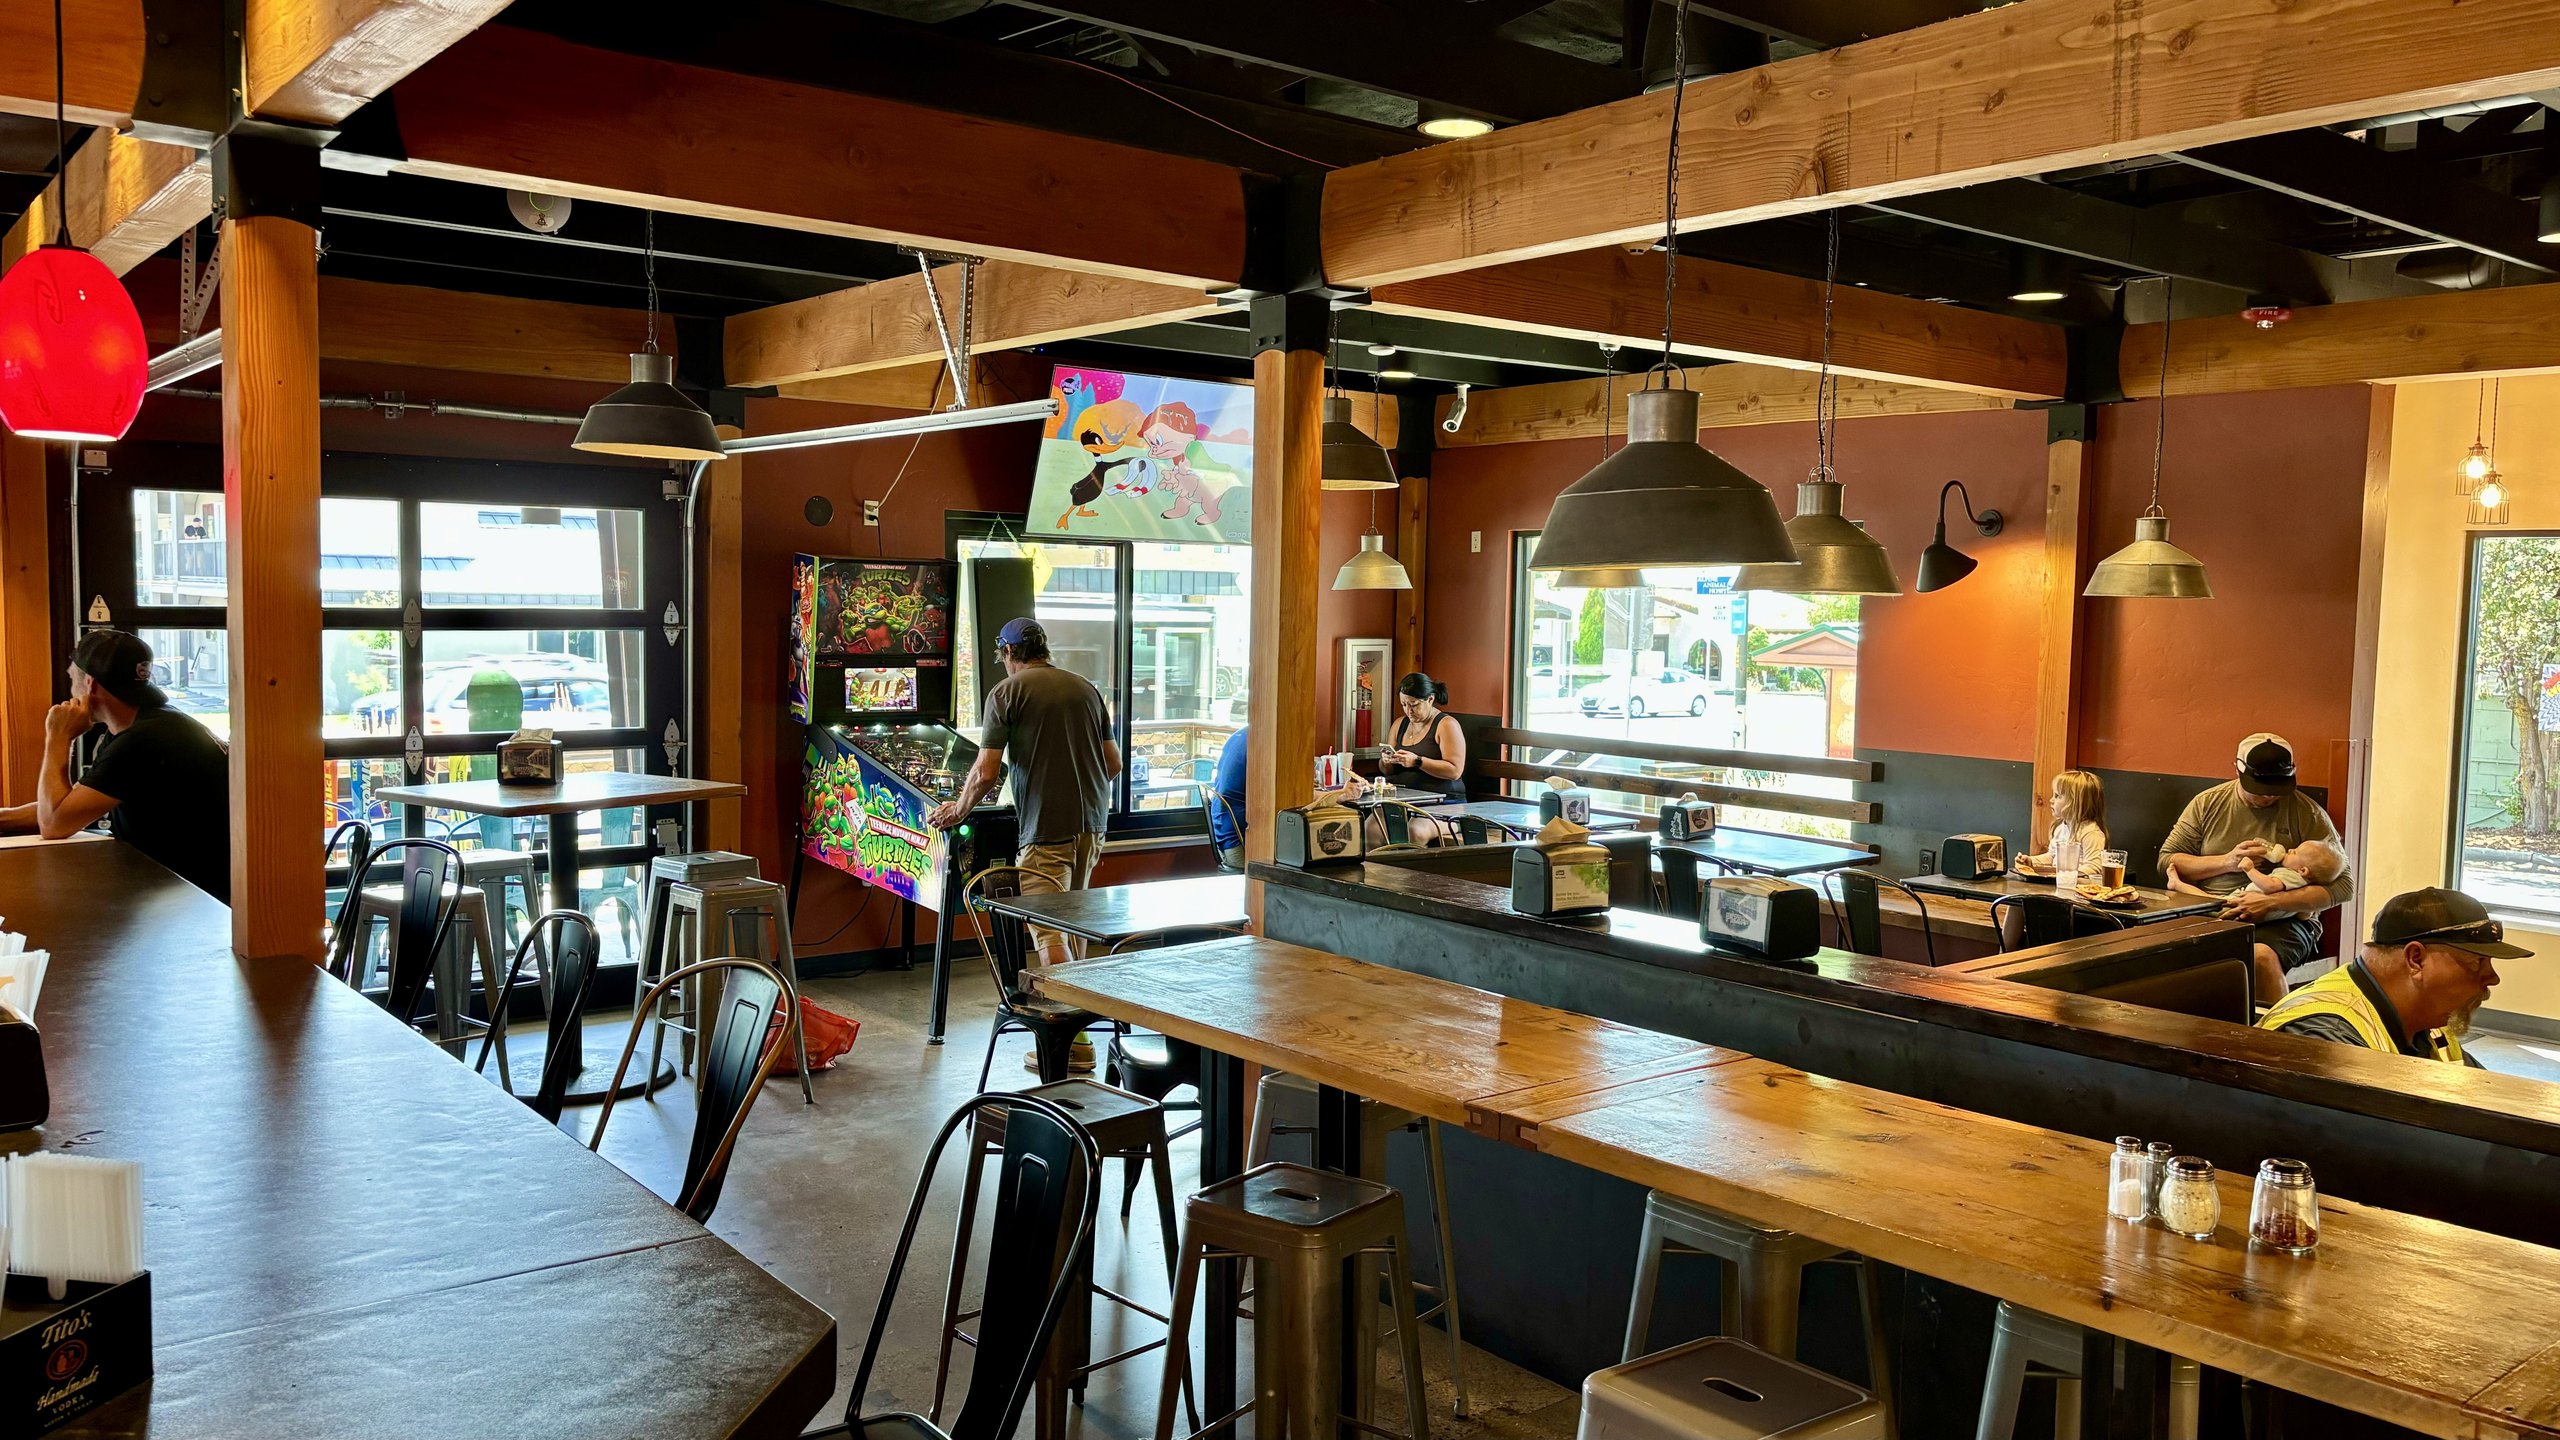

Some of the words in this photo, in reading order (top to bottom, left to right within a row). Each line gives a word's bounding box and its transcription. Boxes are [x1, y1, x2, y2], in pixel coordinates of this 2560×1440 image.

[860, 570, 911, 586] TURTLES
[858, 832, 933, 880] TURTLES
[41, 1309, 91, 1349] Tito's
[36, 1364, 99, 1411] Handmade
[52, 1394, 85, 1414] VODKA
